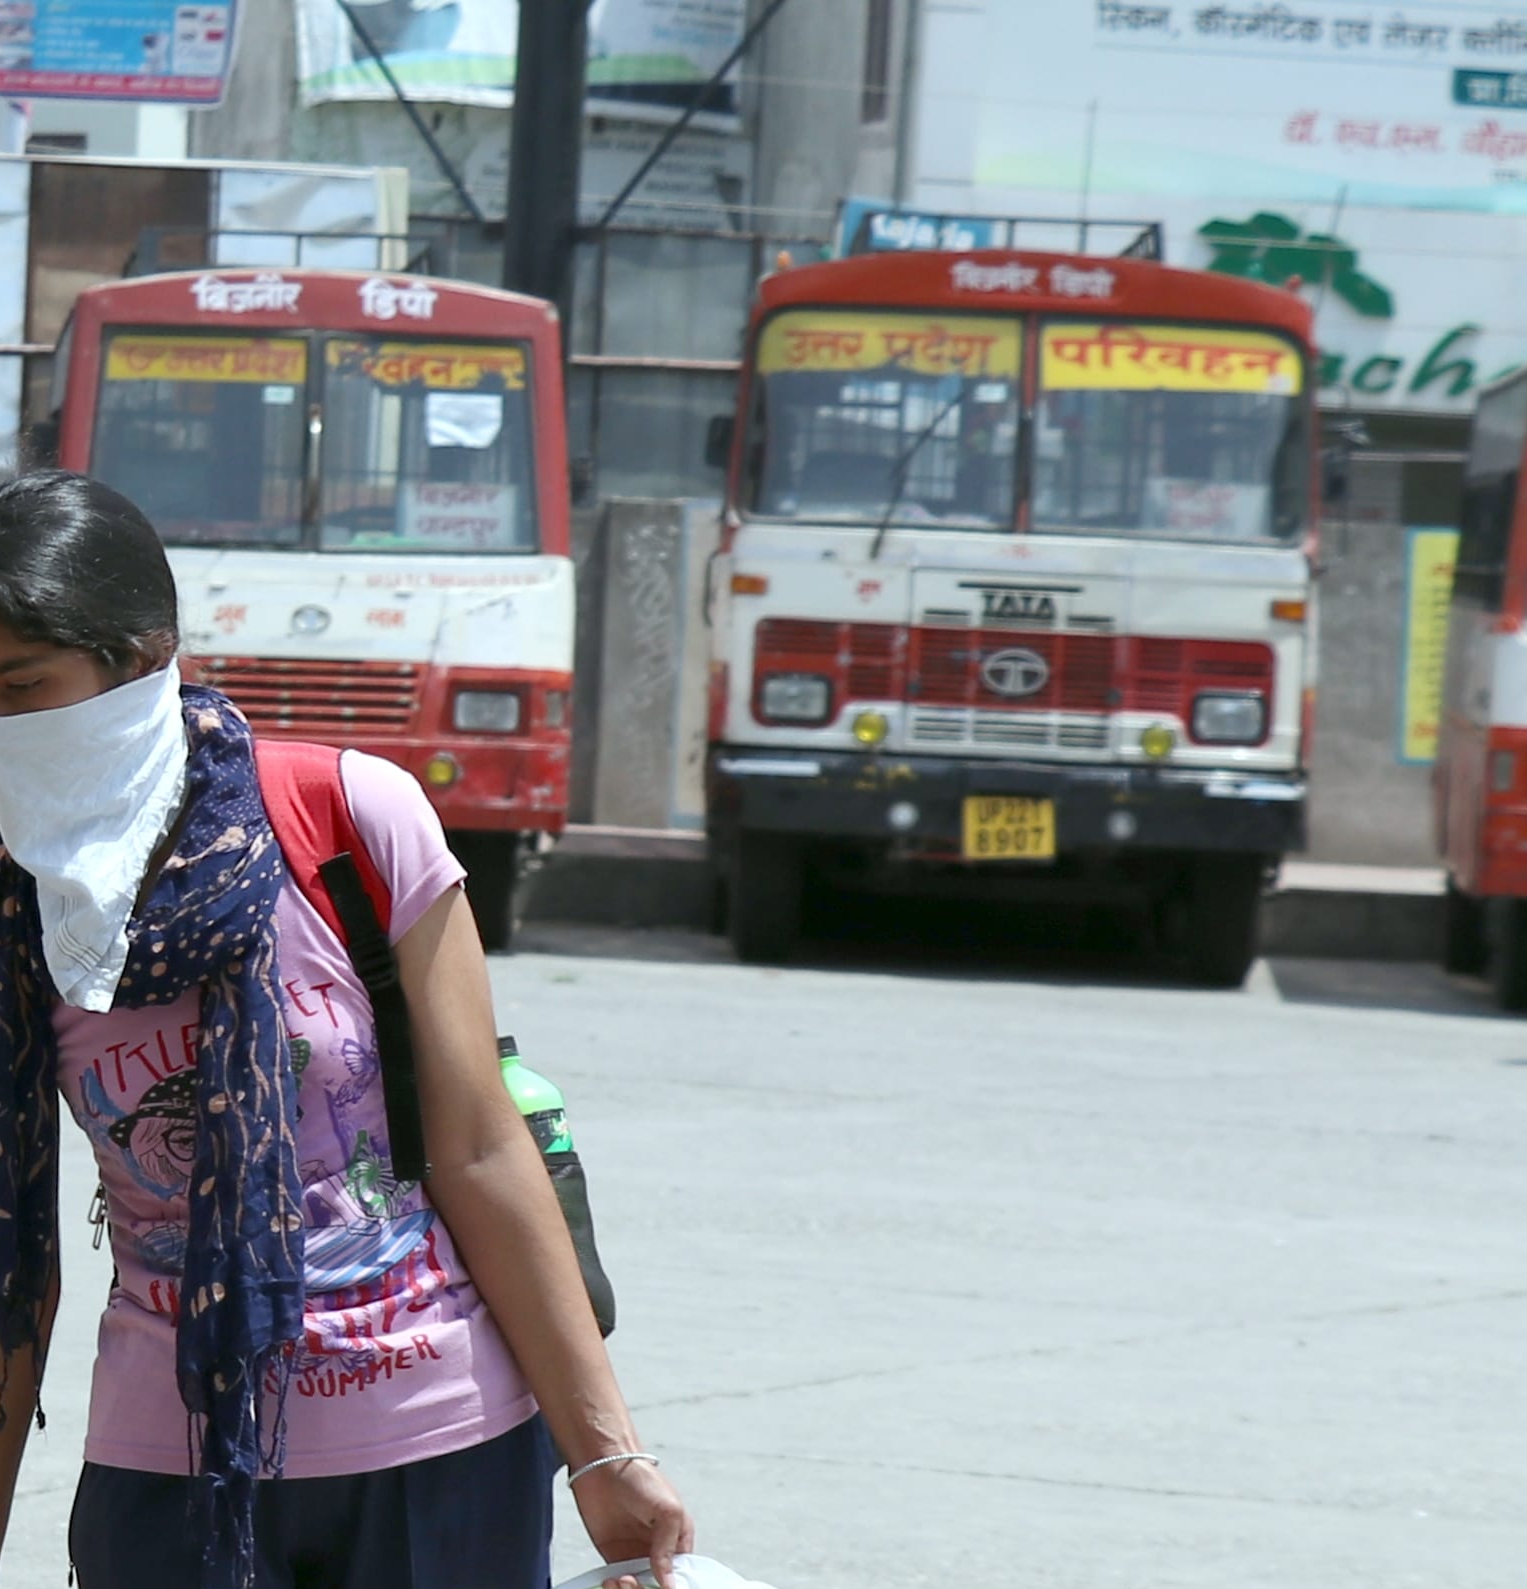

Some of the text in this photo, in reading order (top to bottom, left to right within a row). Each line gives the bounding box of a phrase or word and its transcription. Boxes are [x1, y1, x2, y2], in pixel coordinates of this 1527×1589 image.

[191, 274, 438, 319] बिजनौर डिपो
[1050, 325, 1289, 385] परिवहन
[983, 591, 1057, 618] TATA
[976, 827, 1045, 854] 8907
[297, 1333, 443, 1399] SUMMER
